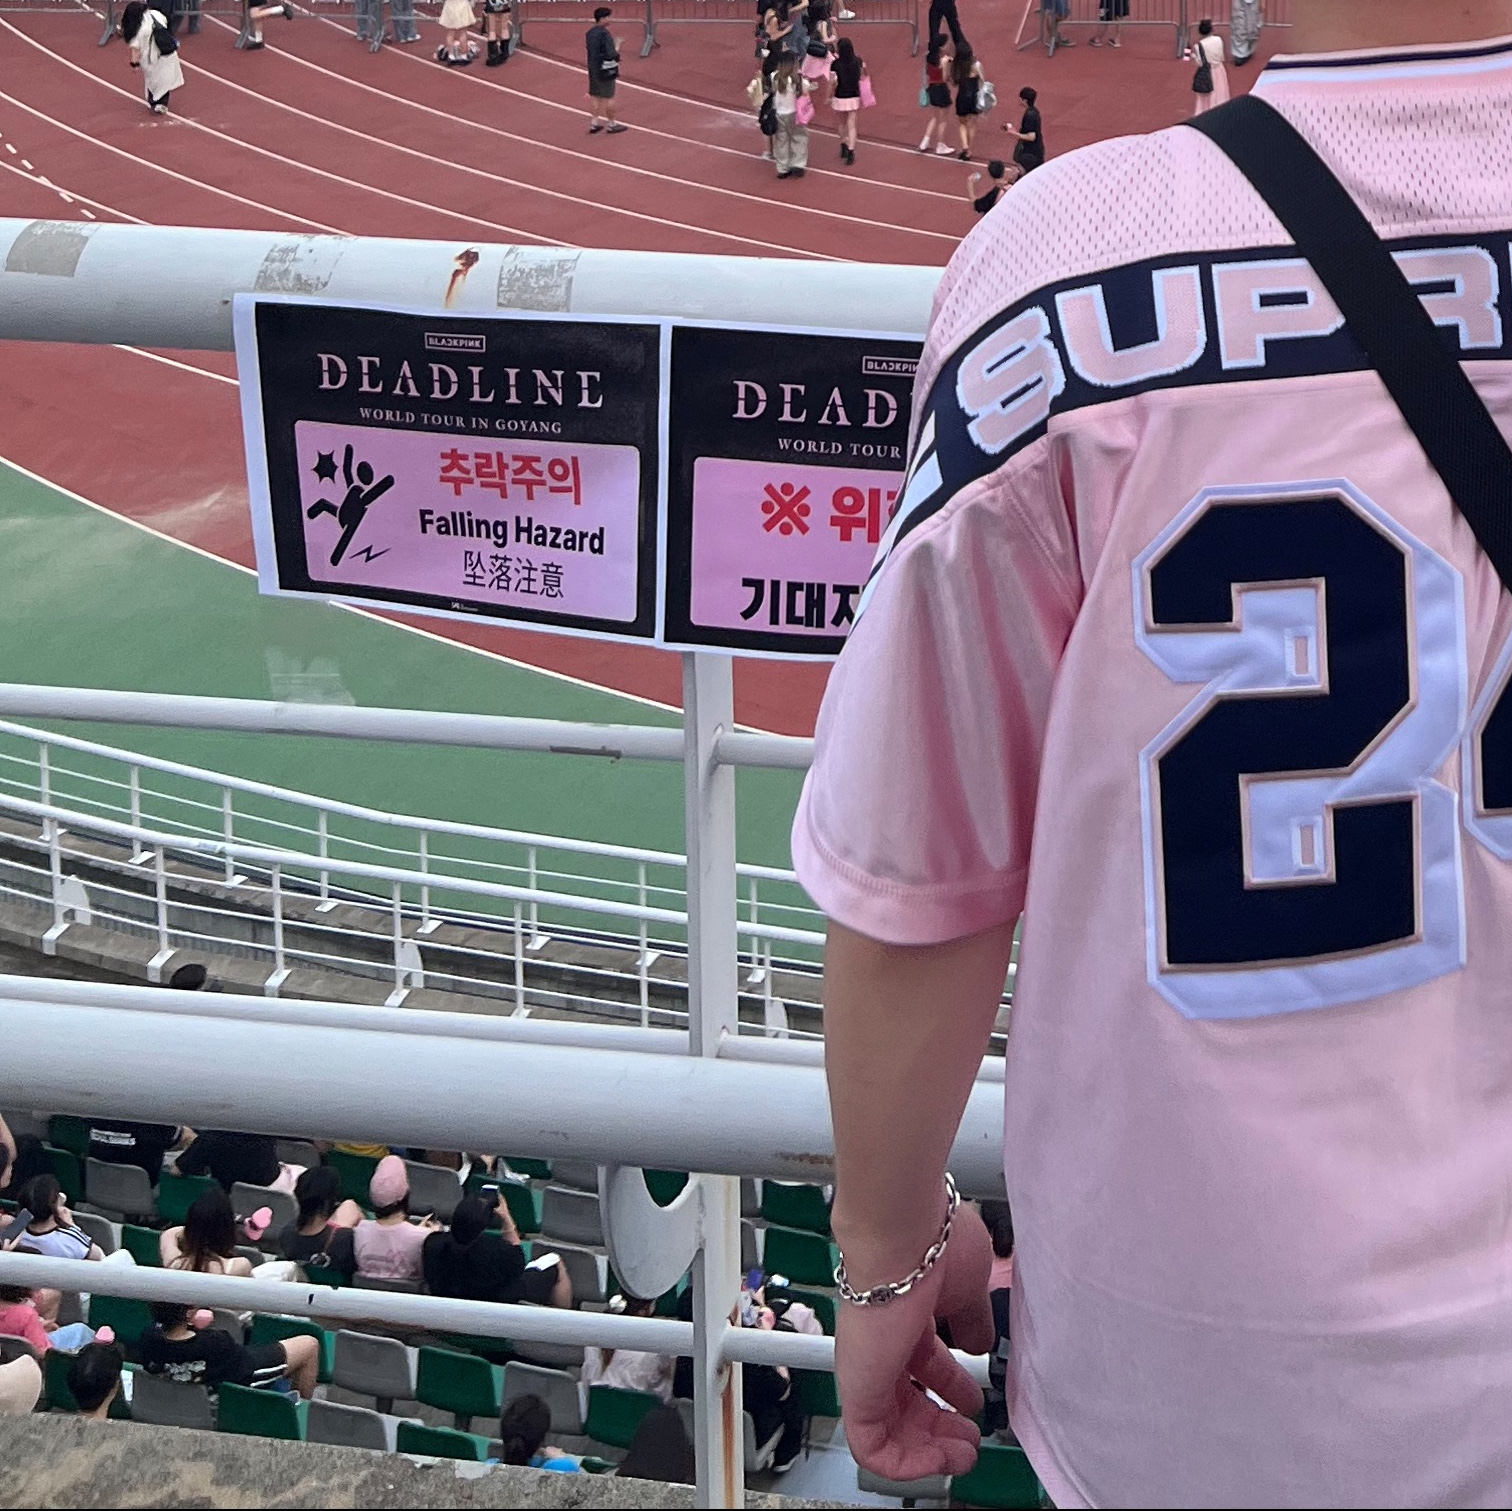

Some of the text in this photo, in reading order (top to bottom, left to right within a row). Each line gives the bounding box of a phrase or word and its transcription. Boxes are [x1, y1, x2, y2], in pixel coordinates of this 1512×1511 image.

[428, 338, 481, 348] BLACKPINK
[317, 353, 604, 408] DEADLINE
[866, 361, 919, 373] BLACKPI
[359, 407, 562, 434] WORLD TOUR IN GOYANG
[732, 380, 899, 428] DEAD
[778, 438, 901, 459] WORLD TOUR
[439, 448, 582, 506] 추락주의
[419, 509, 605, 555] Falling Hazard
[830, 486, 900, 544] 위
